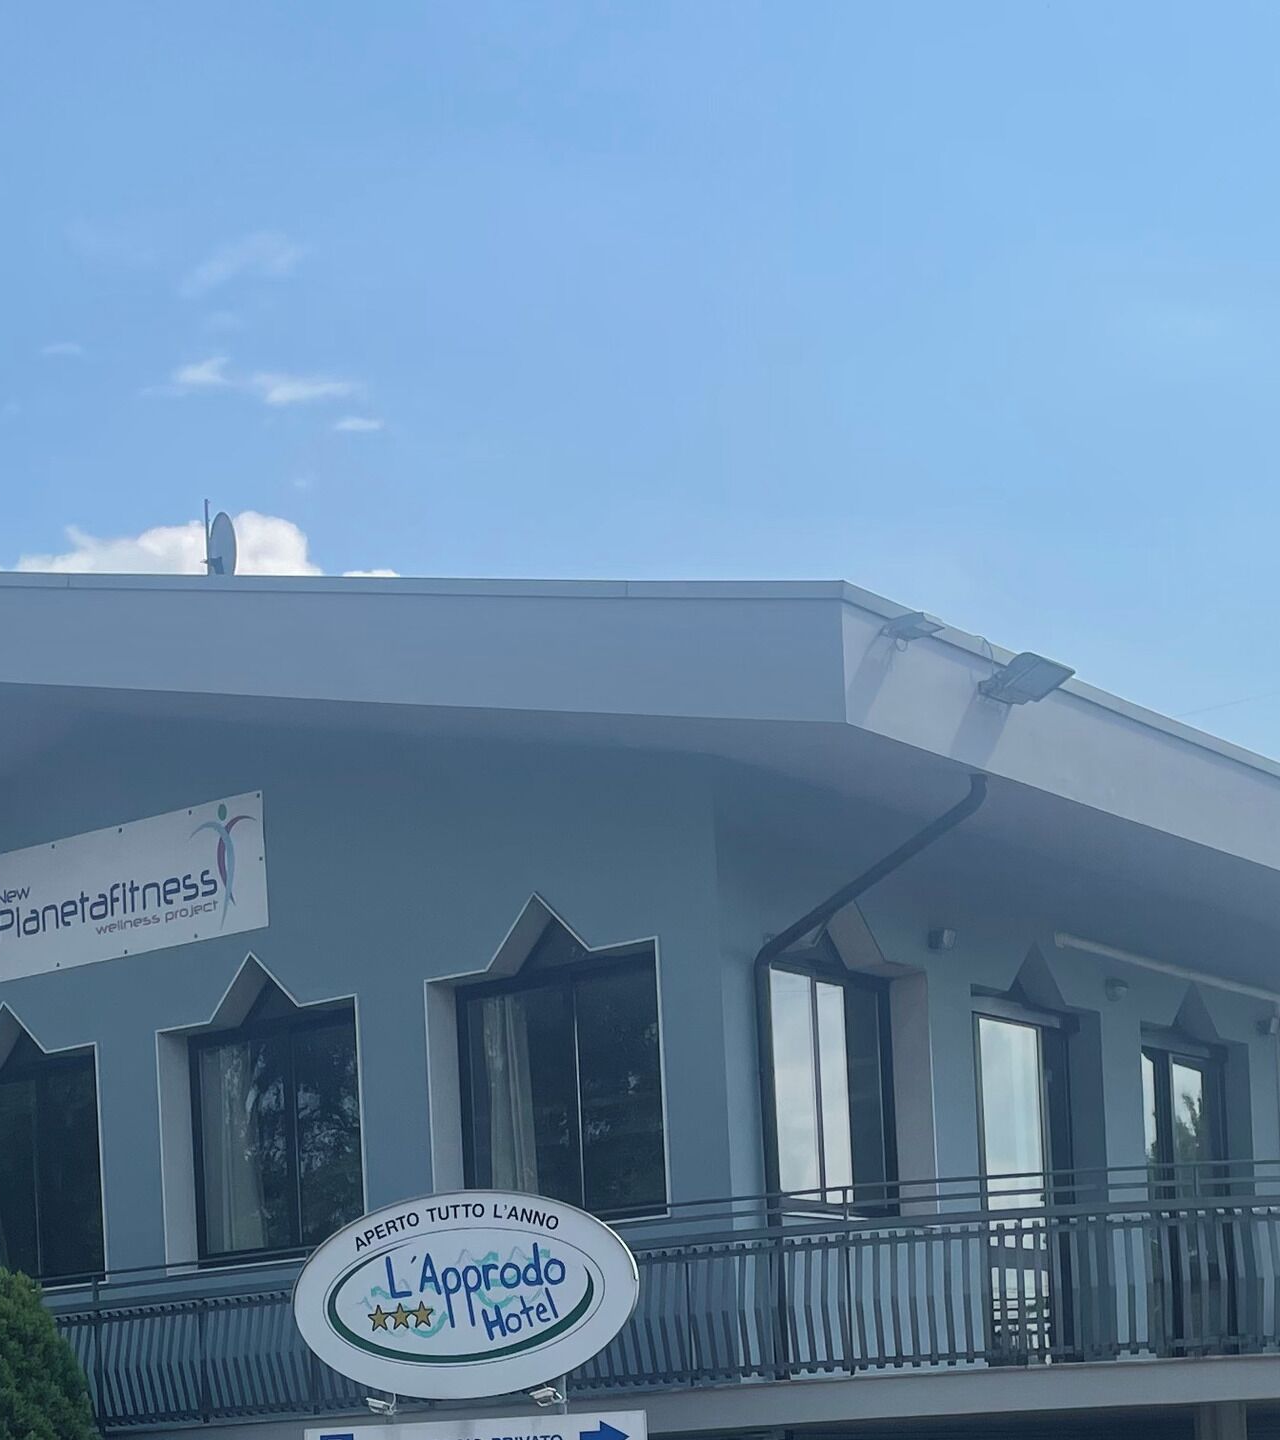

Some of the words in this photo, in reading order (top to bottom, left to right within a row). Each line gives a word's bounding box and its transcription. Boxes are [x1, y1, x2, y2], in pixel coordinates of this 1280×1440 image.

[95, 915, 161, 936] wellness
[164, 900, 220, 924] project
[354, 1211, 420, 1252] APERTO
[425, 1203, 486, 1223] TUTTO
[493, 1203, 560, 1231] L'ANNO
[385, 1241, 567, 1329] L'Approdo
[481, 1287, 560, 1341] Hotel
